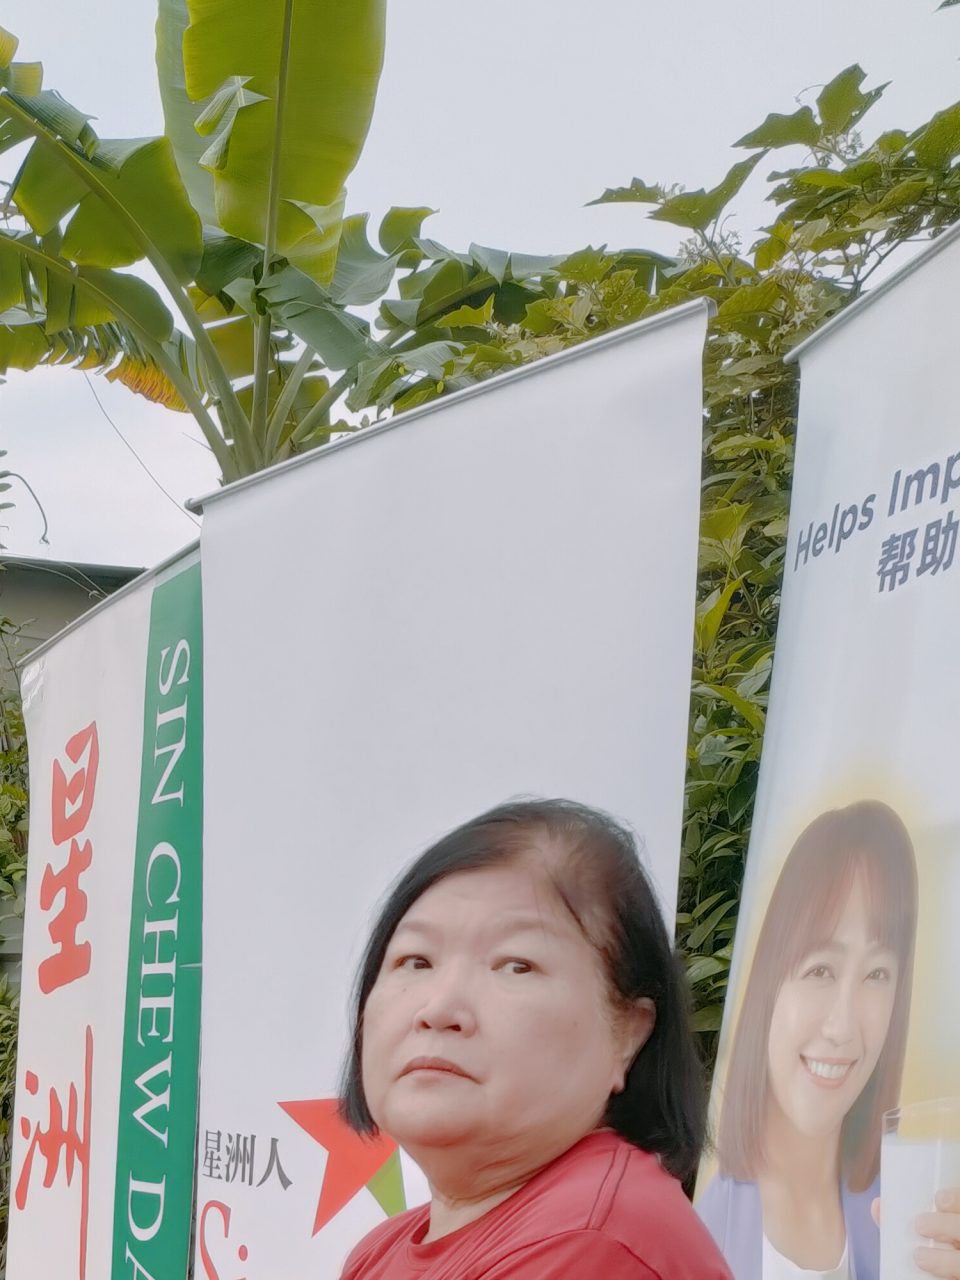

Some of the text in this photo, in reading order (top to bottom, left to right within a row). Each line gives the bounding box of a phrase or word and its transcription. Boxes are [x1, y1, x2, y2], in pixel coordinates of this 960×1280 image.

[794, 494, 877, 573] Helps
[150, 638, 191, 807] SIN
[131, 841, 183, 1149] CHEW
